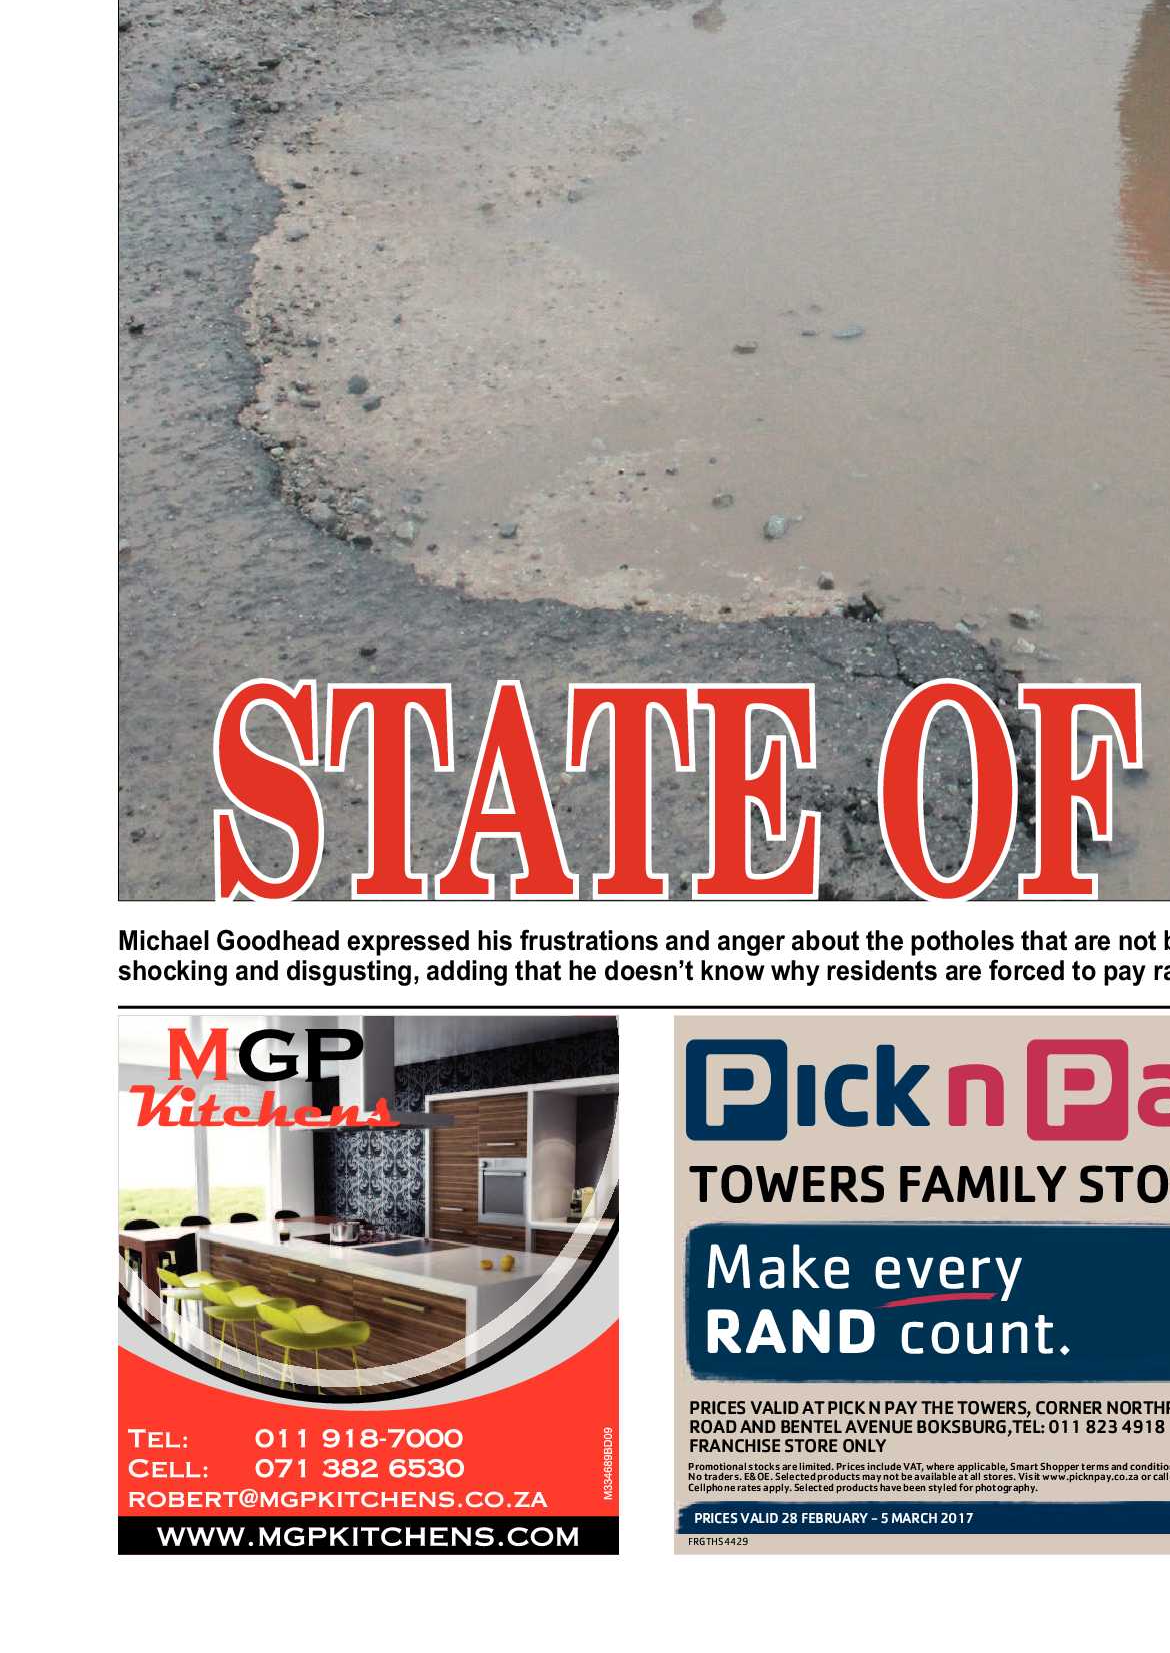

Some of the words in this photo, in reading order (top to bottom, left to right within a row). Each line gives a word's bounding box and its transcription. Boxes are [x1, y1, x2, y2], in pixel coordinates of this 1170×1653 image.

[213, 680, 820, 902] STATE
[877, 680, 1146, 902] OF
[120, 930, 208, 950] Michael
[217, 930, 339, 950] Goodhead
[348, 930, 469, 956] expressed
[479, 930, 512, 950] his
[520, 930, 658, 950] frustrations
[666, 930, 709, 950] and
[718, 935, 785, 956] anger
[168, 1028, 364, 1082] MGP
[128, 1085, 401, 1127] Kitchens
[686, 1039, 930, 1141] Pick
[948, 1063, 1005, 1127] n
[689, 1165, 884, 1203] TOWERS
[900, 1166, 1066, 1202] FAMILY
[707, 1244, 850, 1290] Make
[875, 1256, 1023, 1302] every
[707, 1309, 876, 1354] RAND
[901, 1314, 1070, 1355] count.
[128, 1429, 187, 1448] TEL:
[256, 1429, 305, 1447] 011
[323, 1429, 463, 1448] 918-7000
[129, 1459, 207, 1478] CELL:
[256, 1459, 305, 1477] 071
[323, 1459, 378, 1478] 382
[389, 1459, 464, 1478] 6530
[603, 1426, 614, 1501] M334689BD09
[157, 1527, 578, 1546] WWW.MGPKITCHENS.COM
[694, 1512, 738, 1524] PRICES
[741, 1512, 779, 1524] VALID
[782, 1512, 798, 1524] 28
[801, 1512, 869, 1524] FEBRUARY
[880, 1512, 888, 1524] 5
[891, 1512, 938, 1524] MARCH
[941, 1512, 974, 1524] 2017
